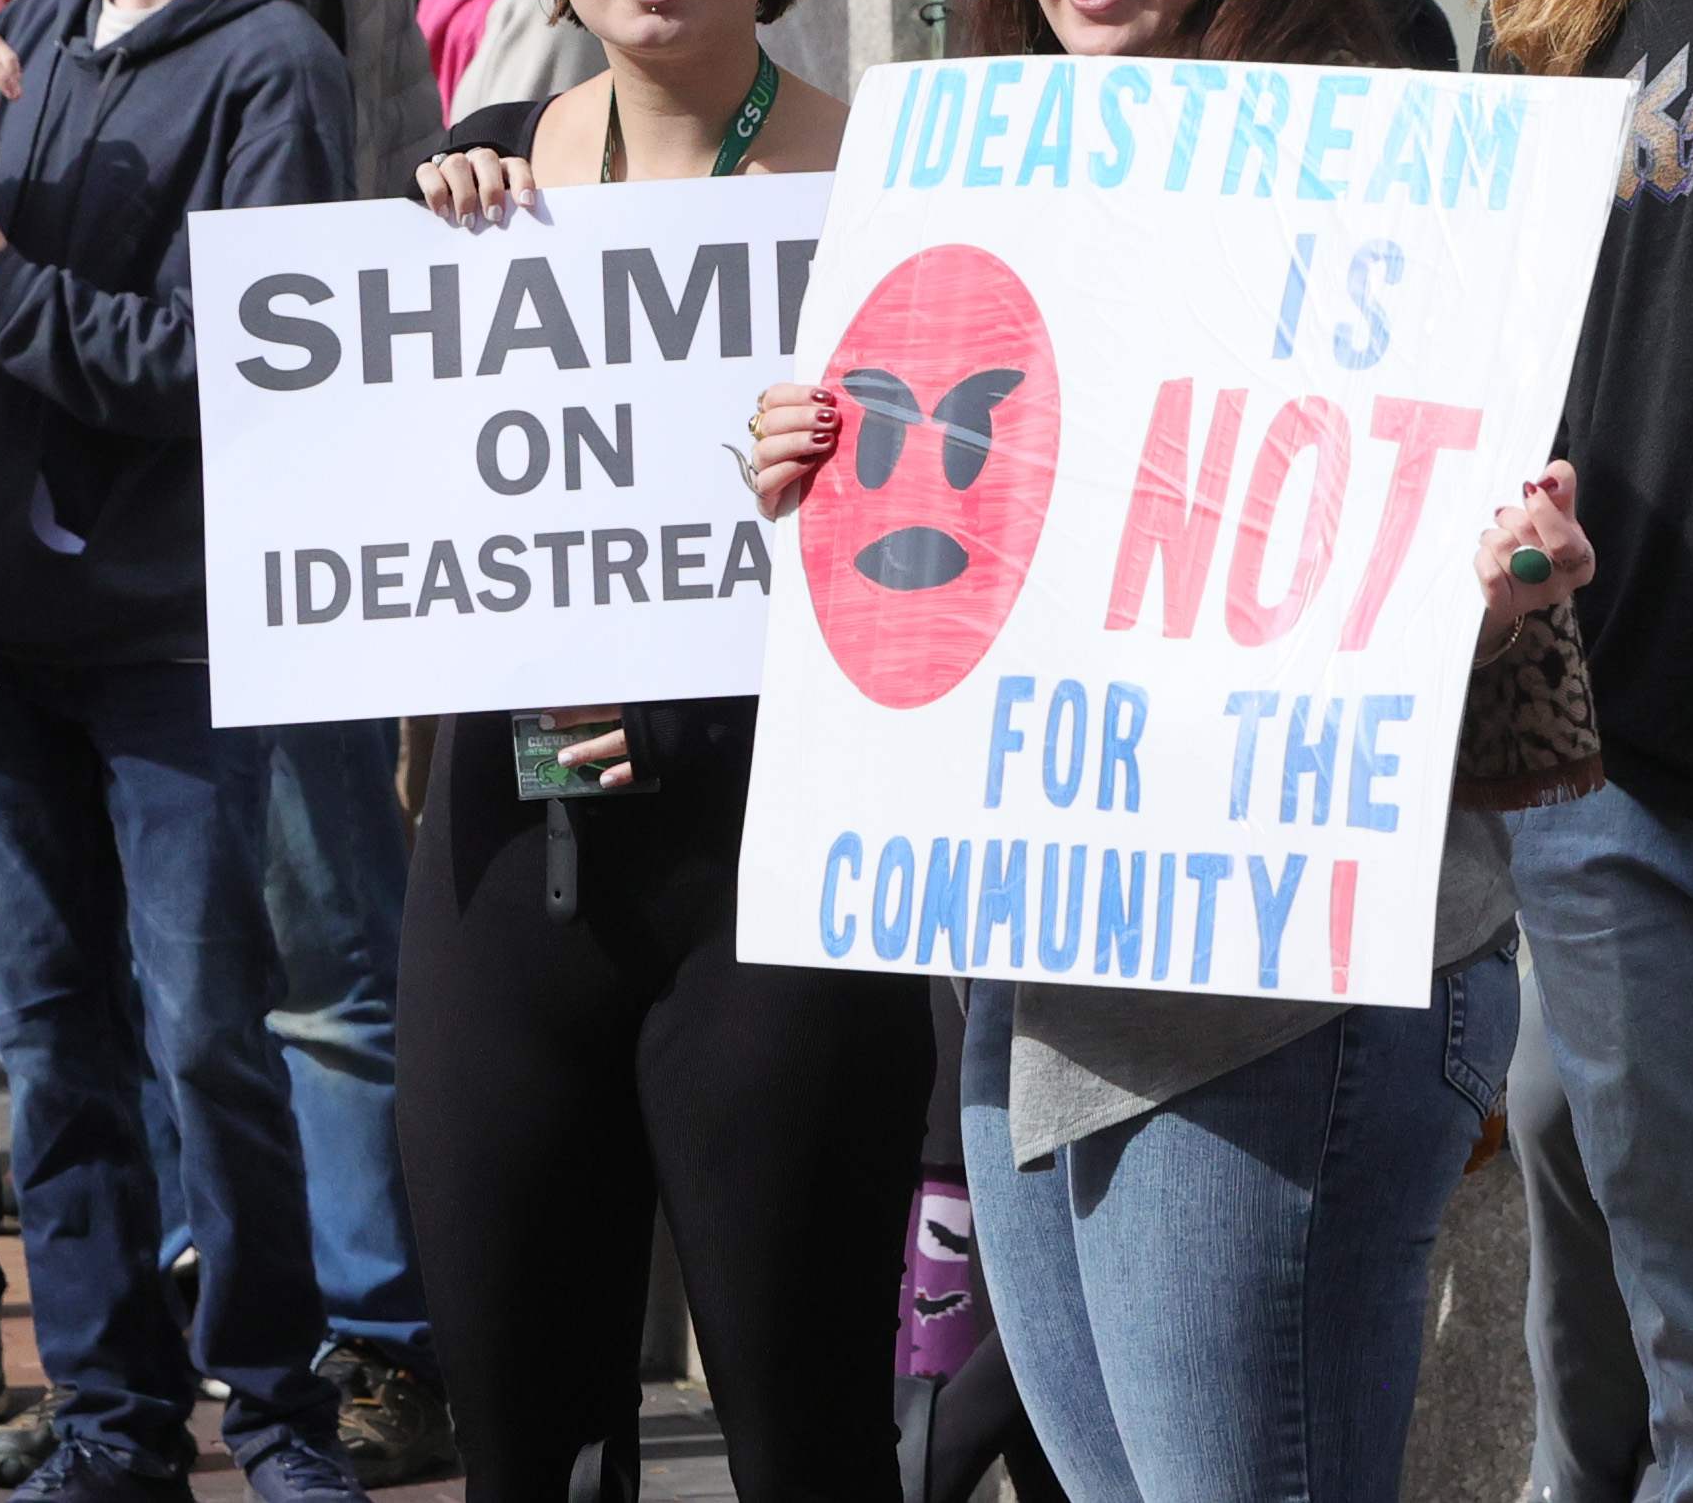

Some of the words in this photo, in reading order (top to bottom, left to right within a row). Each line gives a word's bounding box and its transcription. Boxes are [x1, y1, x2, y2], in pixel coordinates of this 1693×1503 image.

[736, 84, 771, 139] CSU
[882, 60, 1532, 212] IDEASTREAM
[1272, 233, 1406, 371] IS
[476, 402, 636, 497] ON
[1104, 376, 1483, 653] NOT
[983, 674, 1150, 814] FOR
[1222, 689, 1415, 834] THE
[817, 829, 1360, 996] COMMUNITY!
